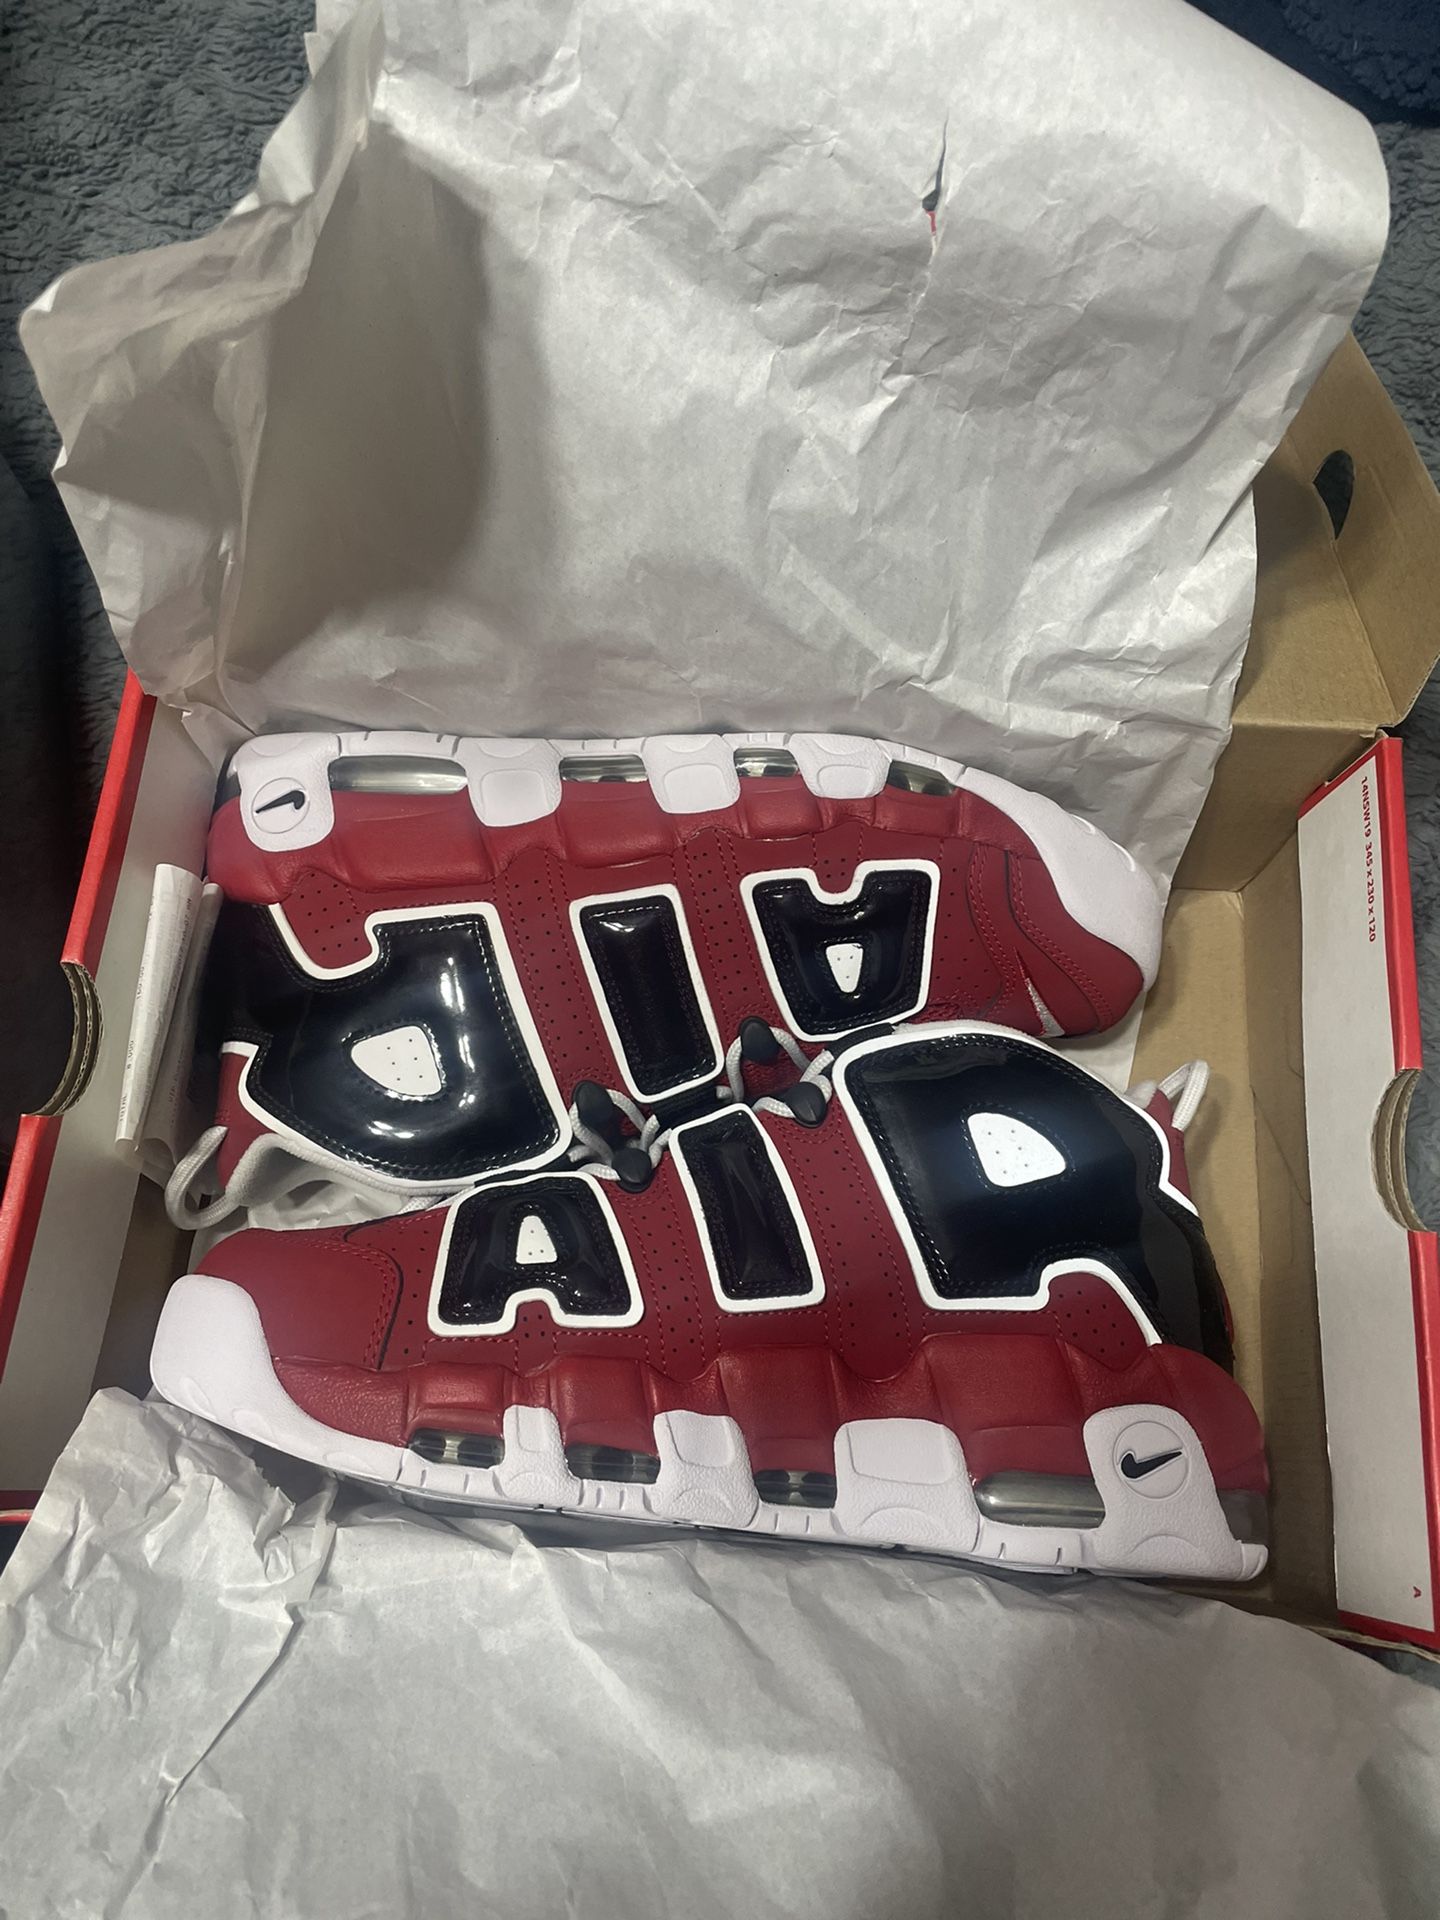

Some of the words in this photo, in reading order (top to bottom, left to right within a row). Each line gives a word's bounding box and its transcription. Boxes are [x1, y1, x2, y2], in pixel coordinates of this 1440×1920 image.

[1360, 776, 1372, 838] 14NSW19
[1365, 841, 1374, 867] 345
[1367, 879, 1375, 904] 230
[1368, 917, 1376, 942] 120
